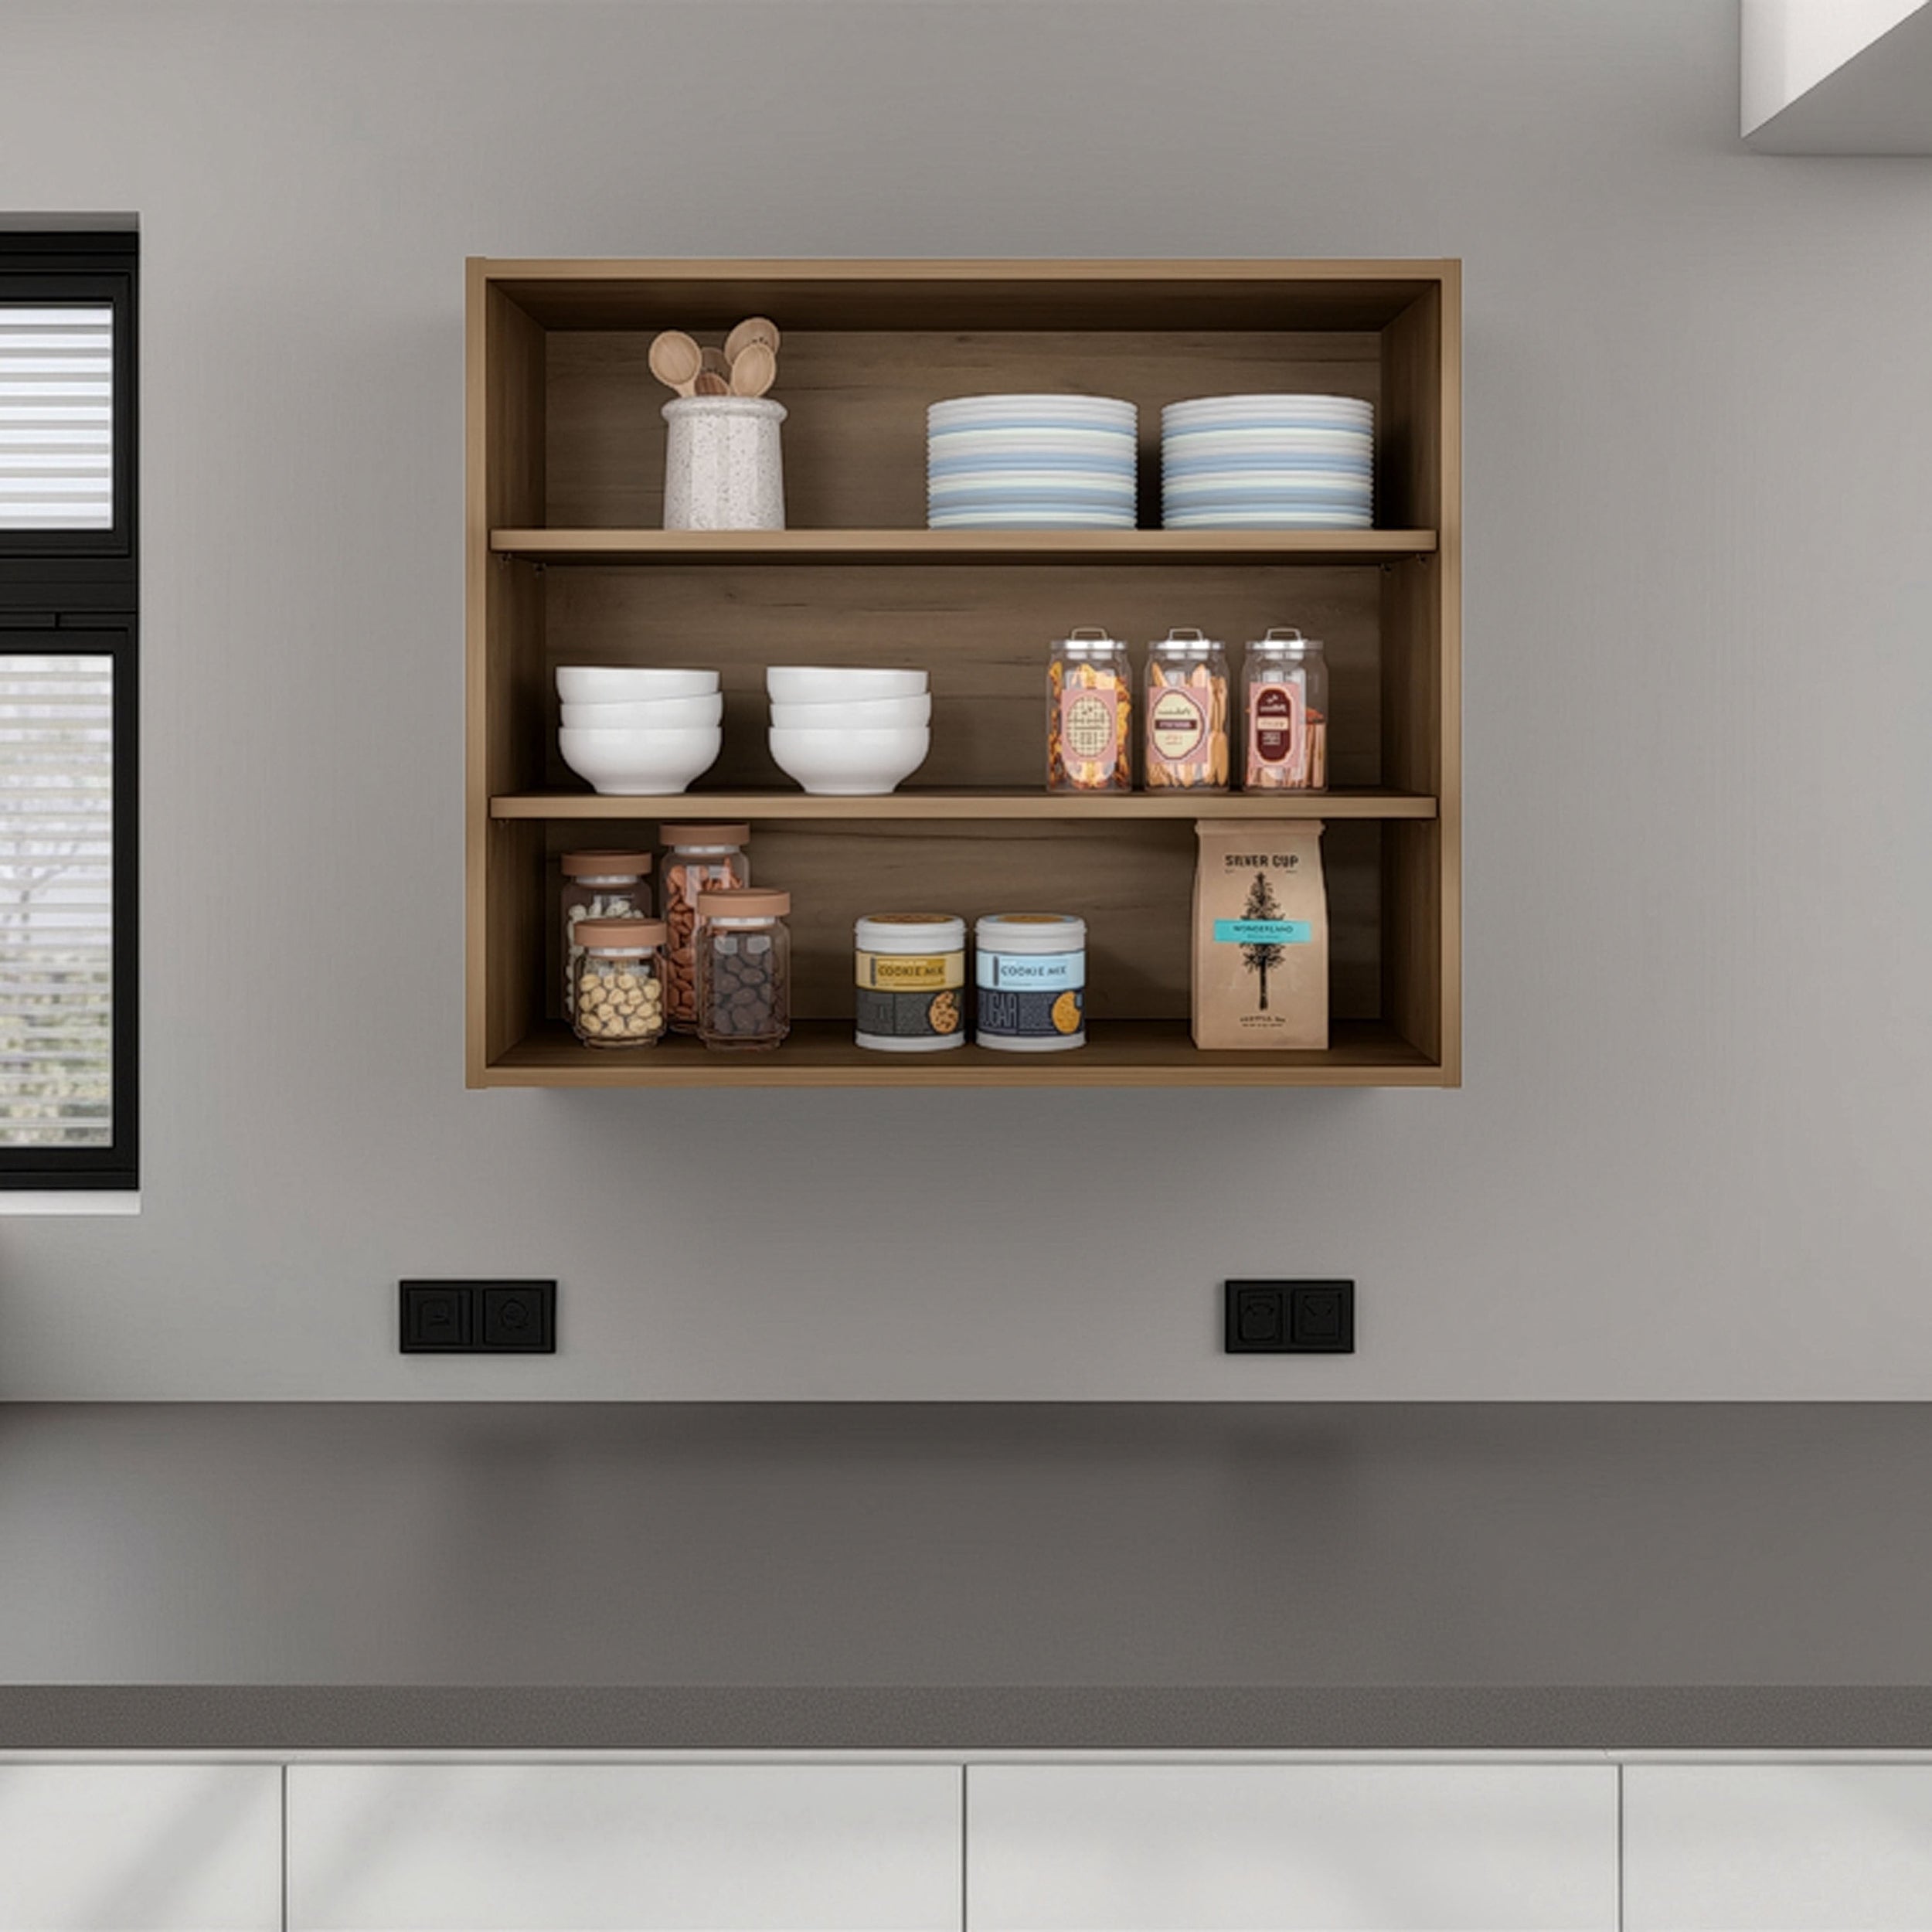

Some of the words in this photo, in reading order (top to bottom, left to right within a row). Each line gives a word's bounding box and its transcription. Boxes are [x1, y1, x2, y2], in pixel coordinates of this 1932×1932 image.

[1225, 855, 1268, 867] SILVER
[1272, 855, 1298, 868] CUP
[878, 966, 921, 976] COOKIE
[1001, 966, 1044, 977] COOKIE
